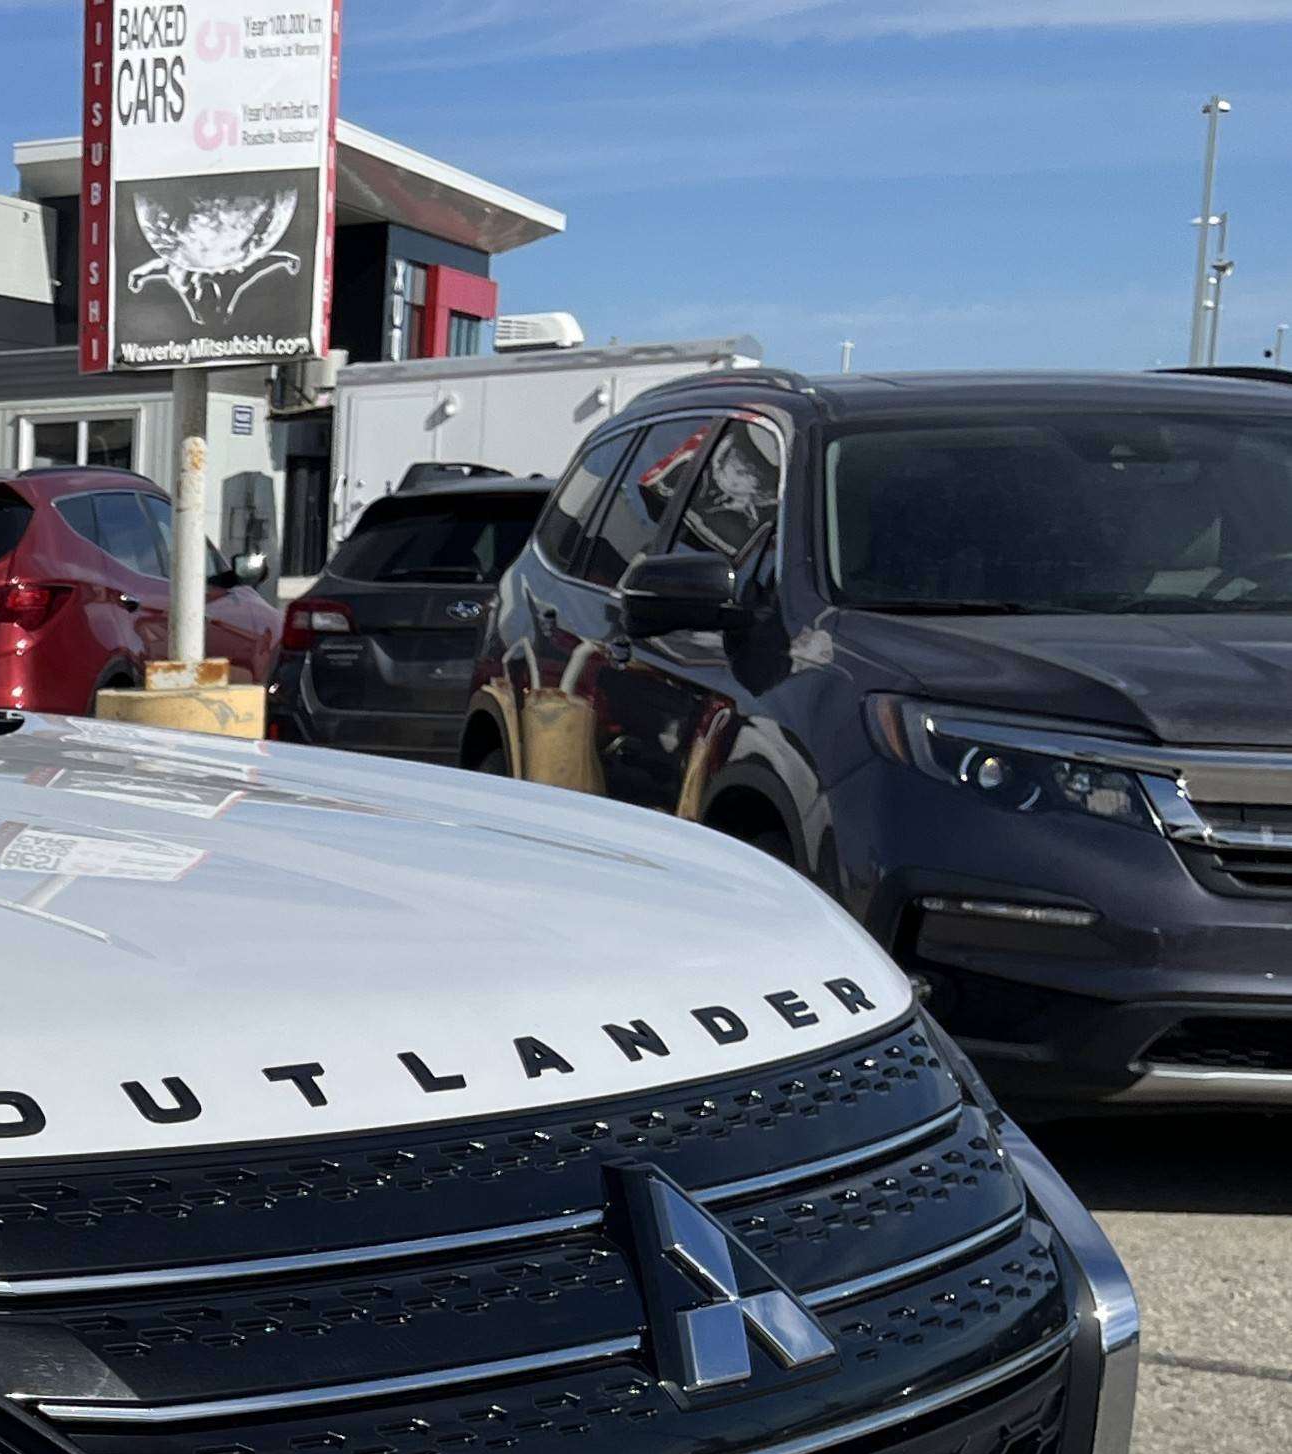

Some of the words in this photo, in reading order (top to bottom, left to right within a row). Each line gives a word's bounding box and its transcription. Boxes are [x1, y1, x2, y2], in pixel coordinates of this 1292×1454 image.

[118, 5, 186, 50] BACKED
[117, 55, 186, 126] CARS
[88, 0, 105, 361] ITSUBISHI
[121, 334, 310, 364] WaverleyMitsubishi.com
